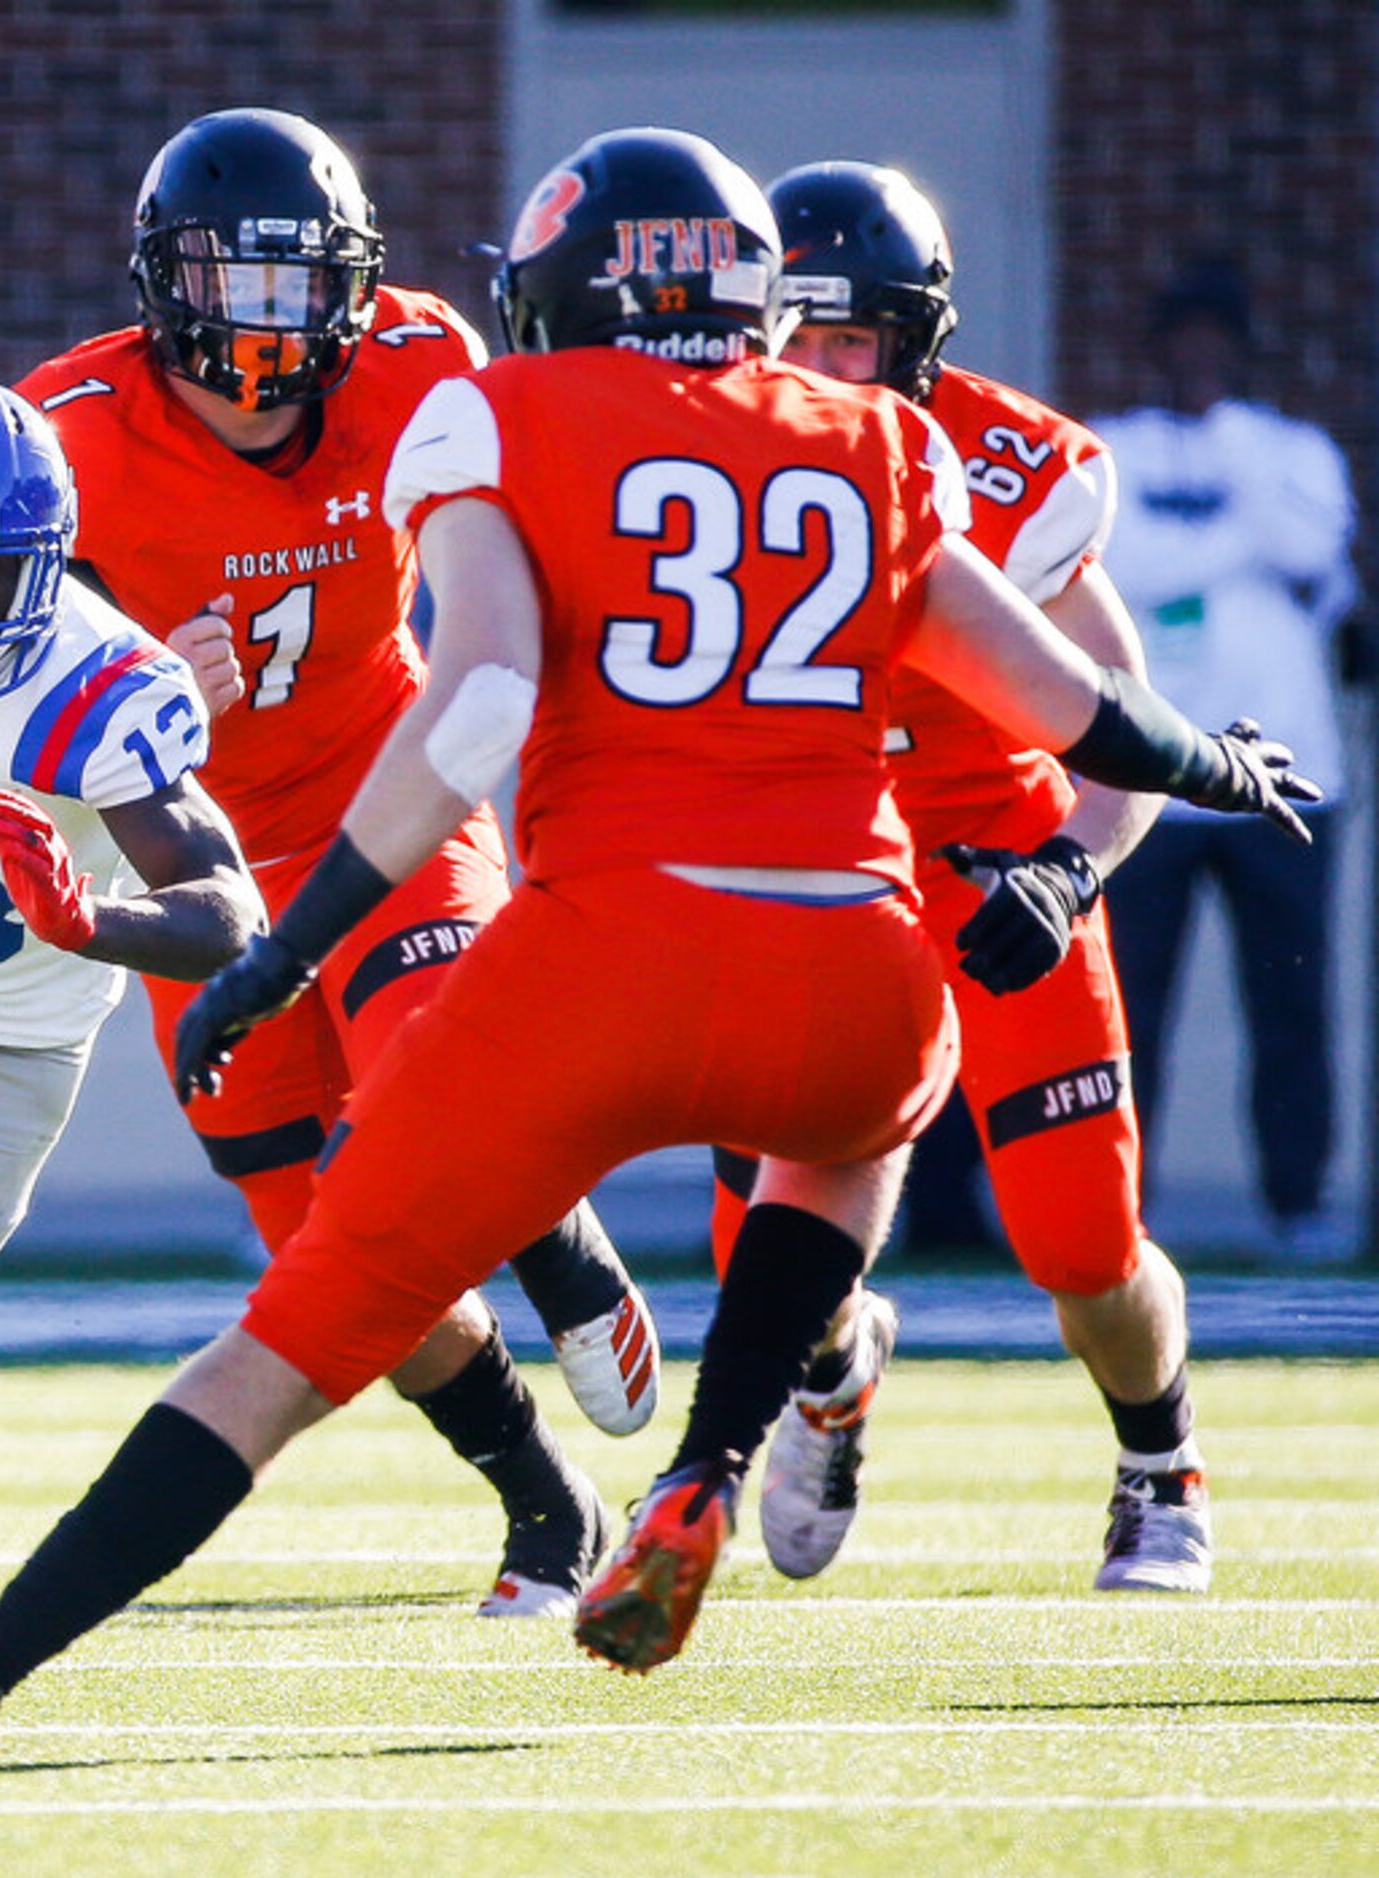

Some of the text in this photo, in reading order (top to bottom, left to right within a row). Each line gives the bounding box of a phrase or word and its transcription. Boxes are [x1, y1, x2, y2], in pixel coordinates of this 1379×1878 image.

[606, 217, 738, 277] JFND
[40, 376, 116, 412] 1
[965, 425, 1053, 508] 62
[224, 537, 359, 580] ROCKWALL
[596, 455, 874, 711] 32
[248, 581, 316, 710] 1
[400, 926, 475, 966] JFND
[1043, 1070, 1114, 1120] JFND
